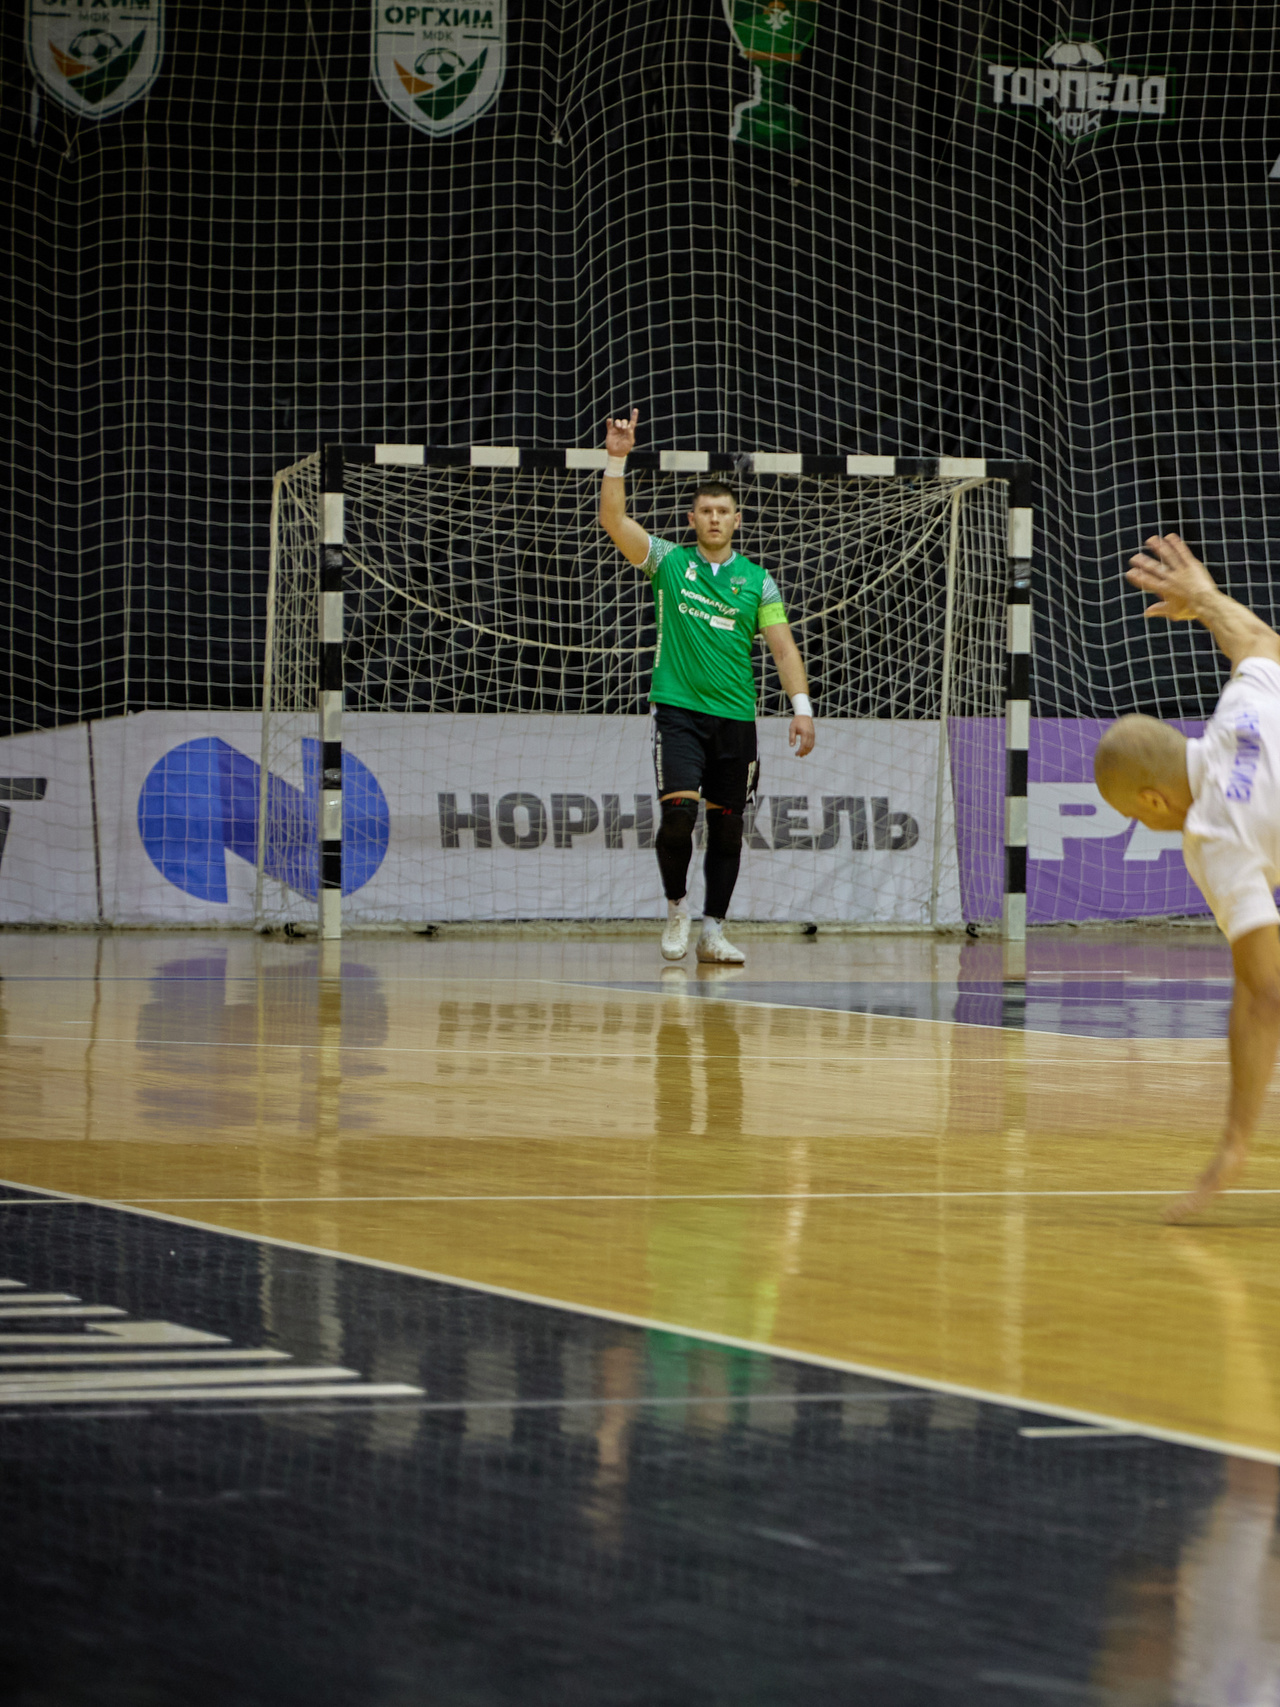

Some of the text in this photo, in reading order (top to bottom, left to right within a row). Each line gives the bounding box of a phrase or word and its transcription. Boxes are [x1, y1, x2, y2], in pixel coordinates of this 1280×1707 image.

[77, 11, 111, 23] МФК
[384, 6, 493, 29] ОРГХИМ
[422, 30, 454, 41] МФК
[988, 65, 1165, 114] ТОРПЕДО
[1046, 110, 1101, 136] МФК
[437, 792, 919, 850] НОРНКЕЛЬ
